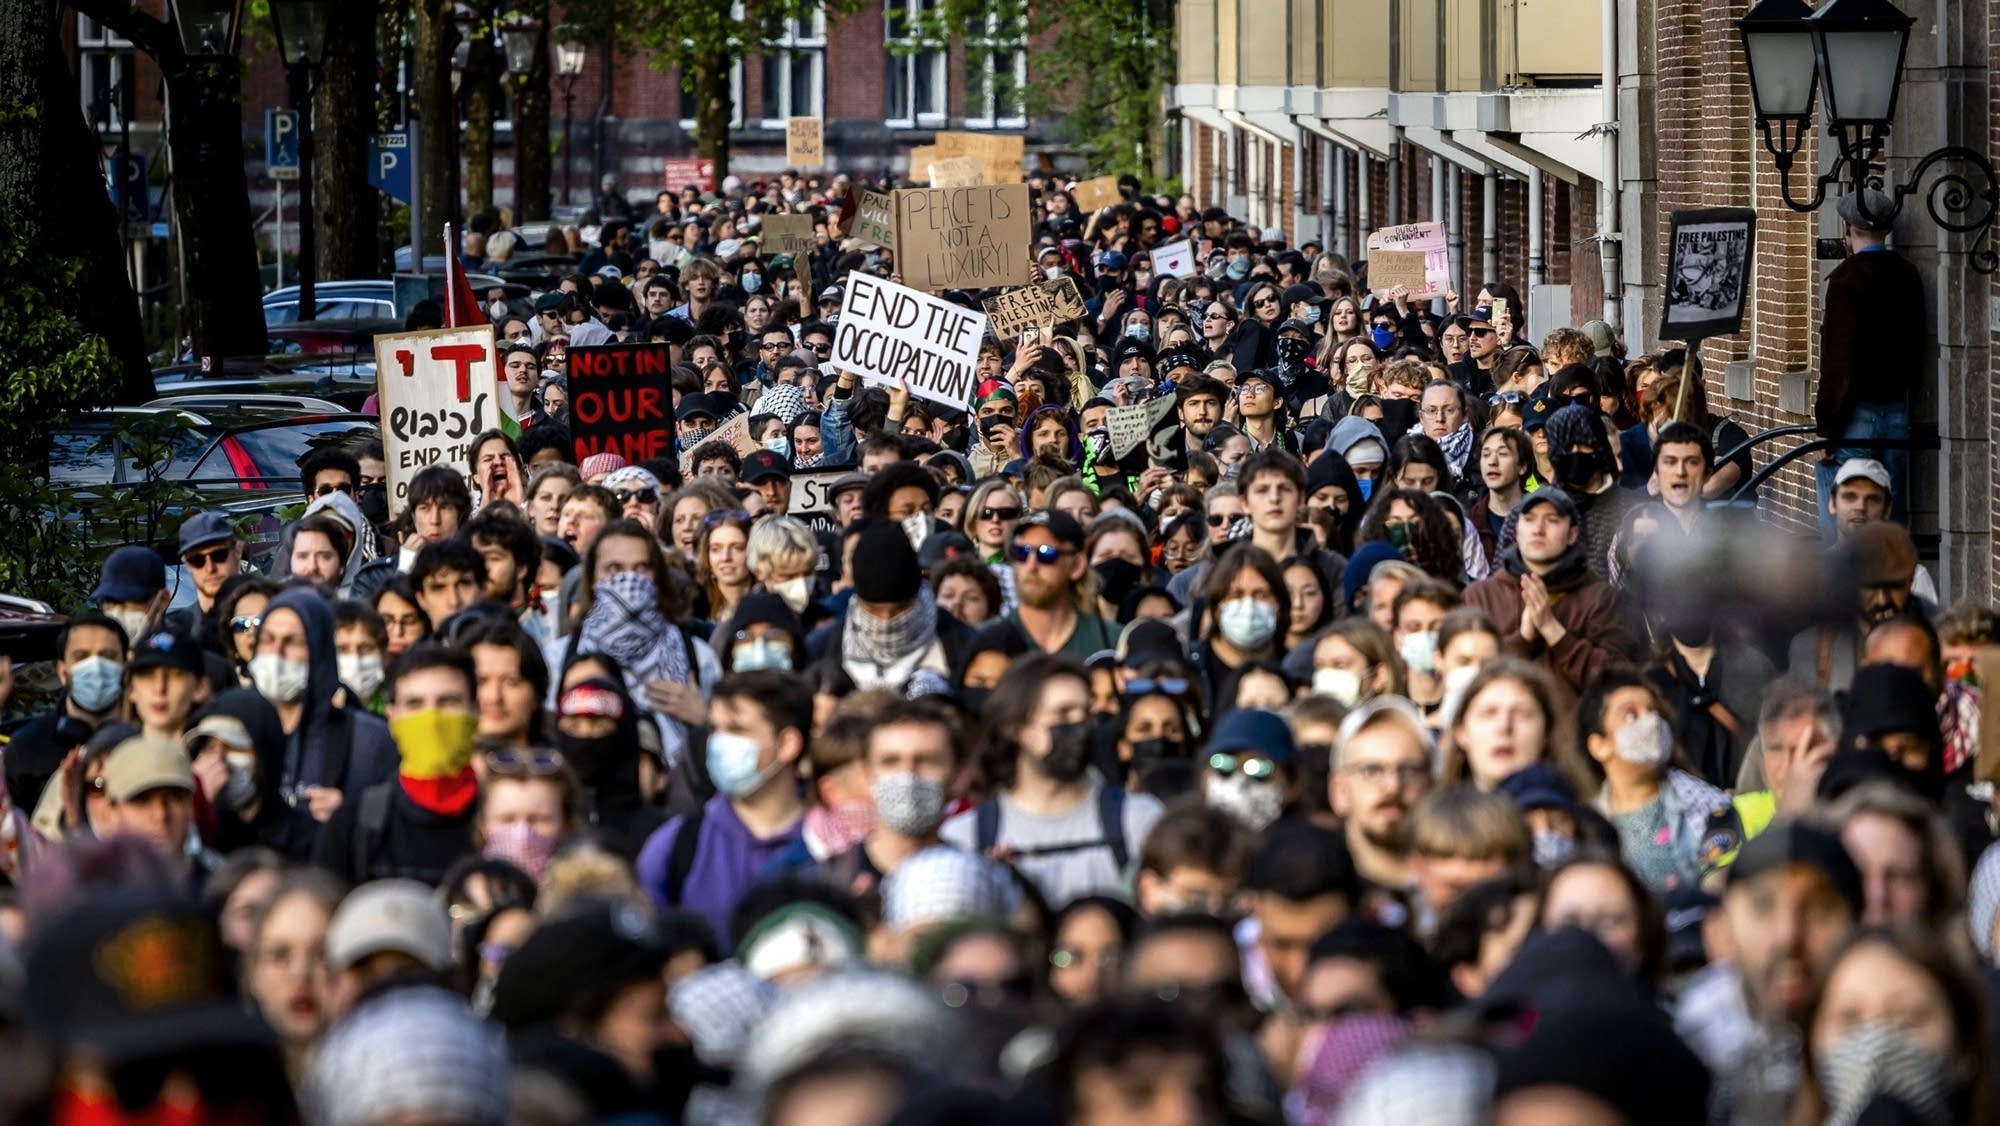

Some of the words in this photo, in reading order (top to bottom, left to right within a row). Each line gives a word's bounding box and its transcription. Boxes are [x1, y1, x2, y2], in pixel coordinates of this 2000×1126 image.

[275, 114, 293, 143] P
[380, 151, 397, 180] P
[863, 192, 891, 210] PALE
[903, 188, 976, 230] PEACE
[989, 188, 1011, 220] IS
[861, 208, 889, 225] WILL
[1395, 225, 1418, 235] DUTCH
[860, 222, 893, 244] FRE
[940, 226, 973, 249] NOT
[978, 225, 993, 245] A
[1384, 230, 1431, 244] GOVERNMENT
[1402, 241, 1411, 249] IS
[1678, 231, 1700, 243] FREE
[1701, 228, 1746, 242] PALESTINE
[926, 242, 1010, 287] LUXURY!
[991, 296, 1060, 330] PALESTINE
[998, 286, 1041, 311] FREE
[847, 279, 920, 329] END
[923, 302, 977, 356] THE
[395, 344, 486, 403] די
[570, 351, 629, 378] NOT
[635, 349, 666, 375] IN
[838, 322, 971, 401] OCCUPATION
[390, 392, 488, 443] לכיבוש
[575, 387, 664, 425] OUR
[400, 447, 441, 469] END
[446, 443, 471, 463] TH
[574, 429, 669, 466] NAME
[801, 480, 832, 510] ST
